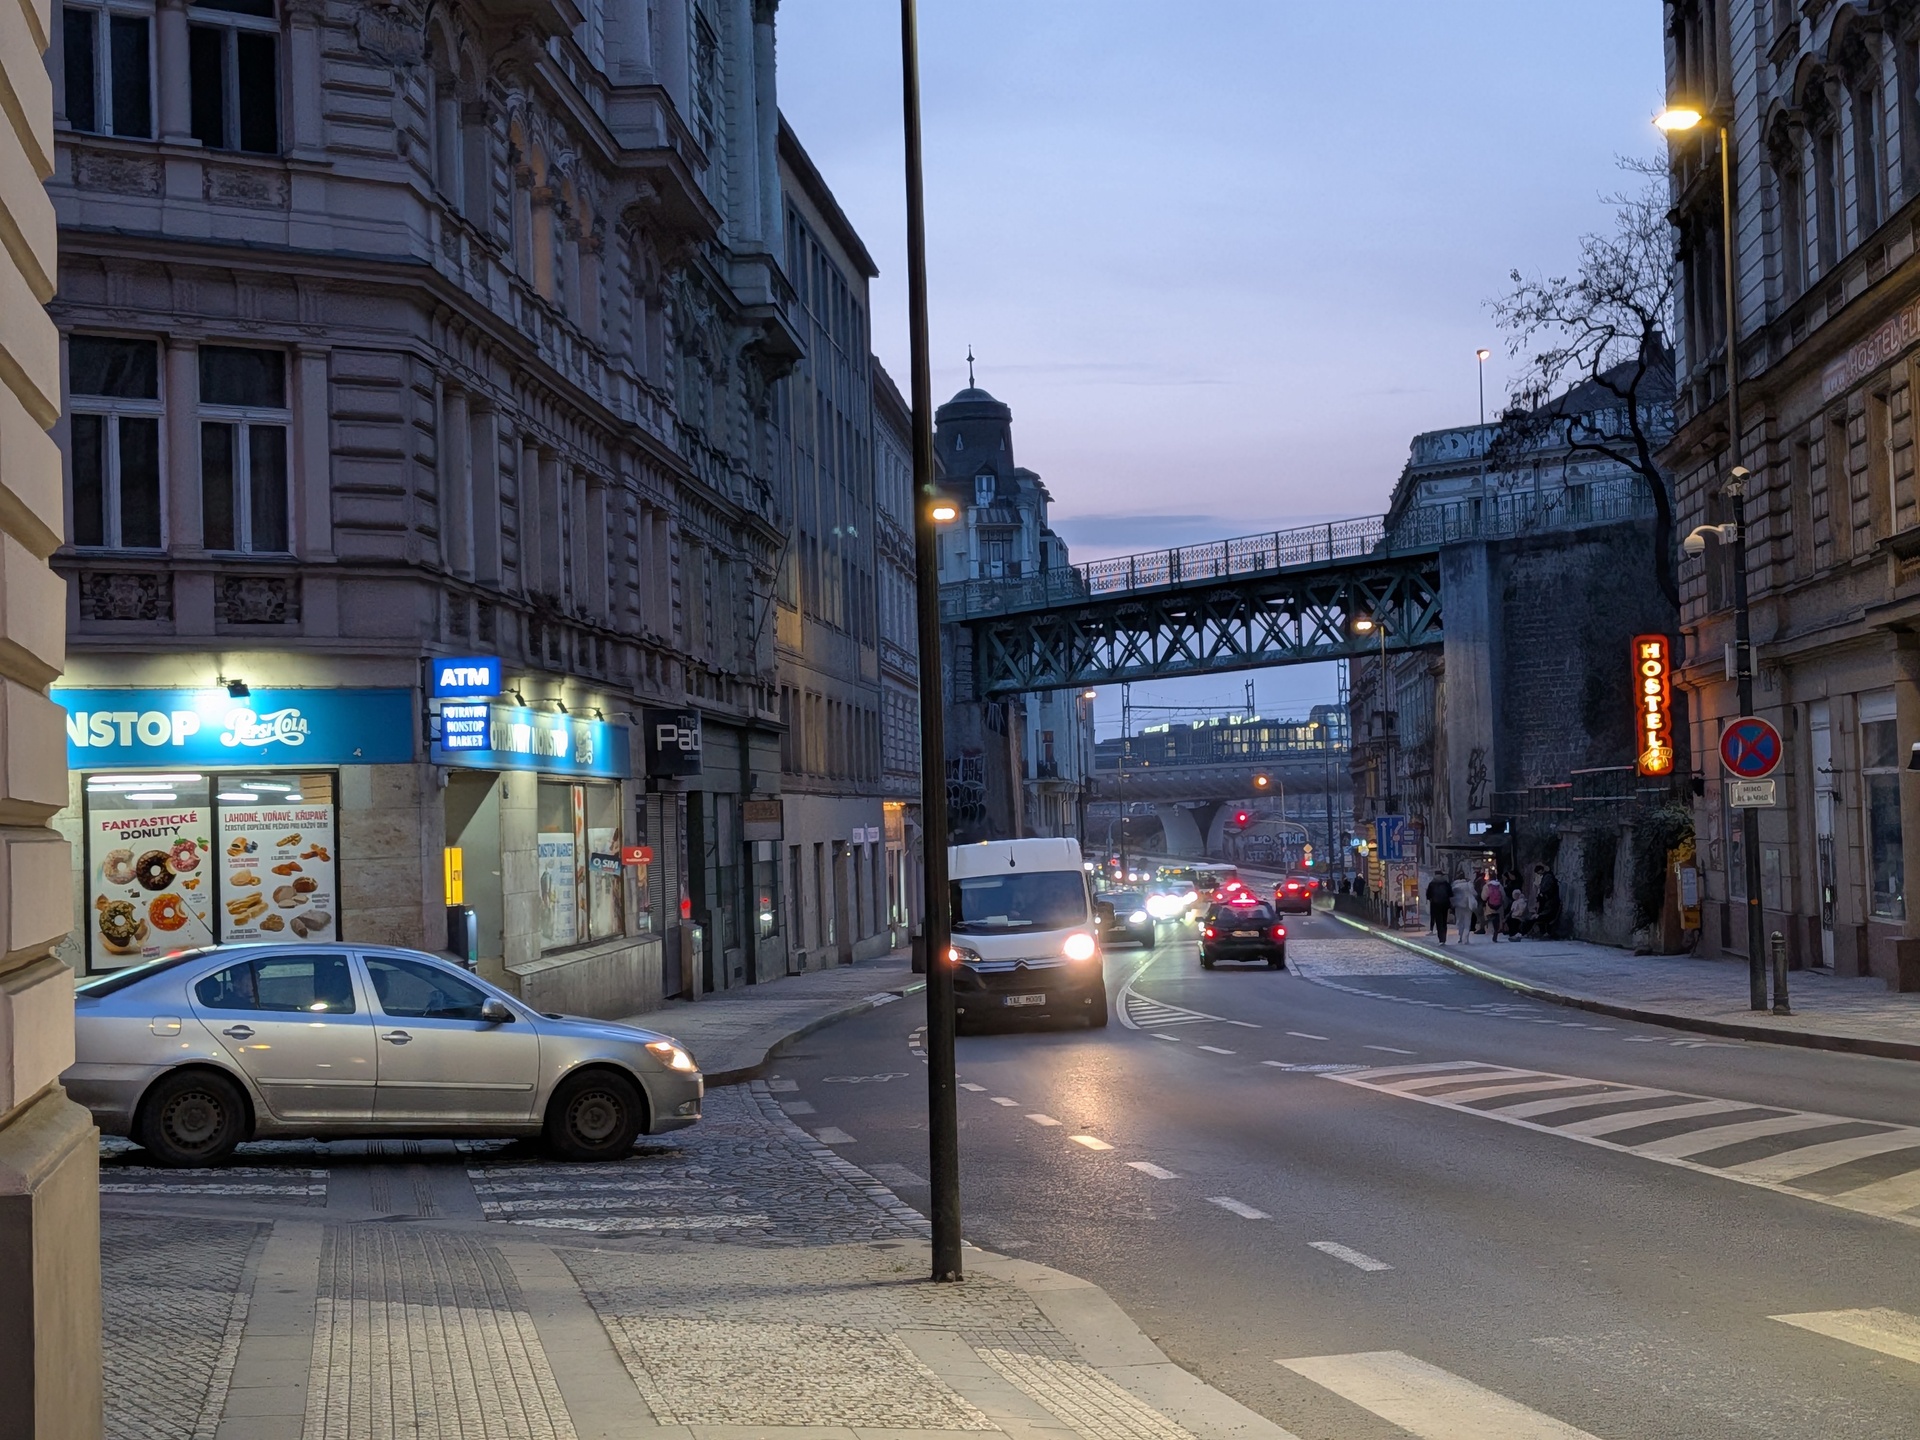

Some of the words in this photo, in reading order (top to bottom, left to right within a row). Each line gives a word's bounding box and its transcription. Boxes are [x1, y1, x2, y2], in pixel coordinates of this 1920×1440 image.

[1849, 326, 1898, 375] HOSTEL
[440, 667, 490, 687] ATM
[1640, 643, 1663, 746] HOSTEL
[447, 721, 485, 733] NONSTOP
[677, 715, 696, 728] The
[448, 735, 484, 747] MARKET
[532, 726, 568, 758] NONSTOP
[656, 723, 701, 751] Pad
[102, 810, 198, 831] FANTASTICKÉ
[120, 826, 182, 841] DONUTY
[602, 859, 619, 869] SIM
